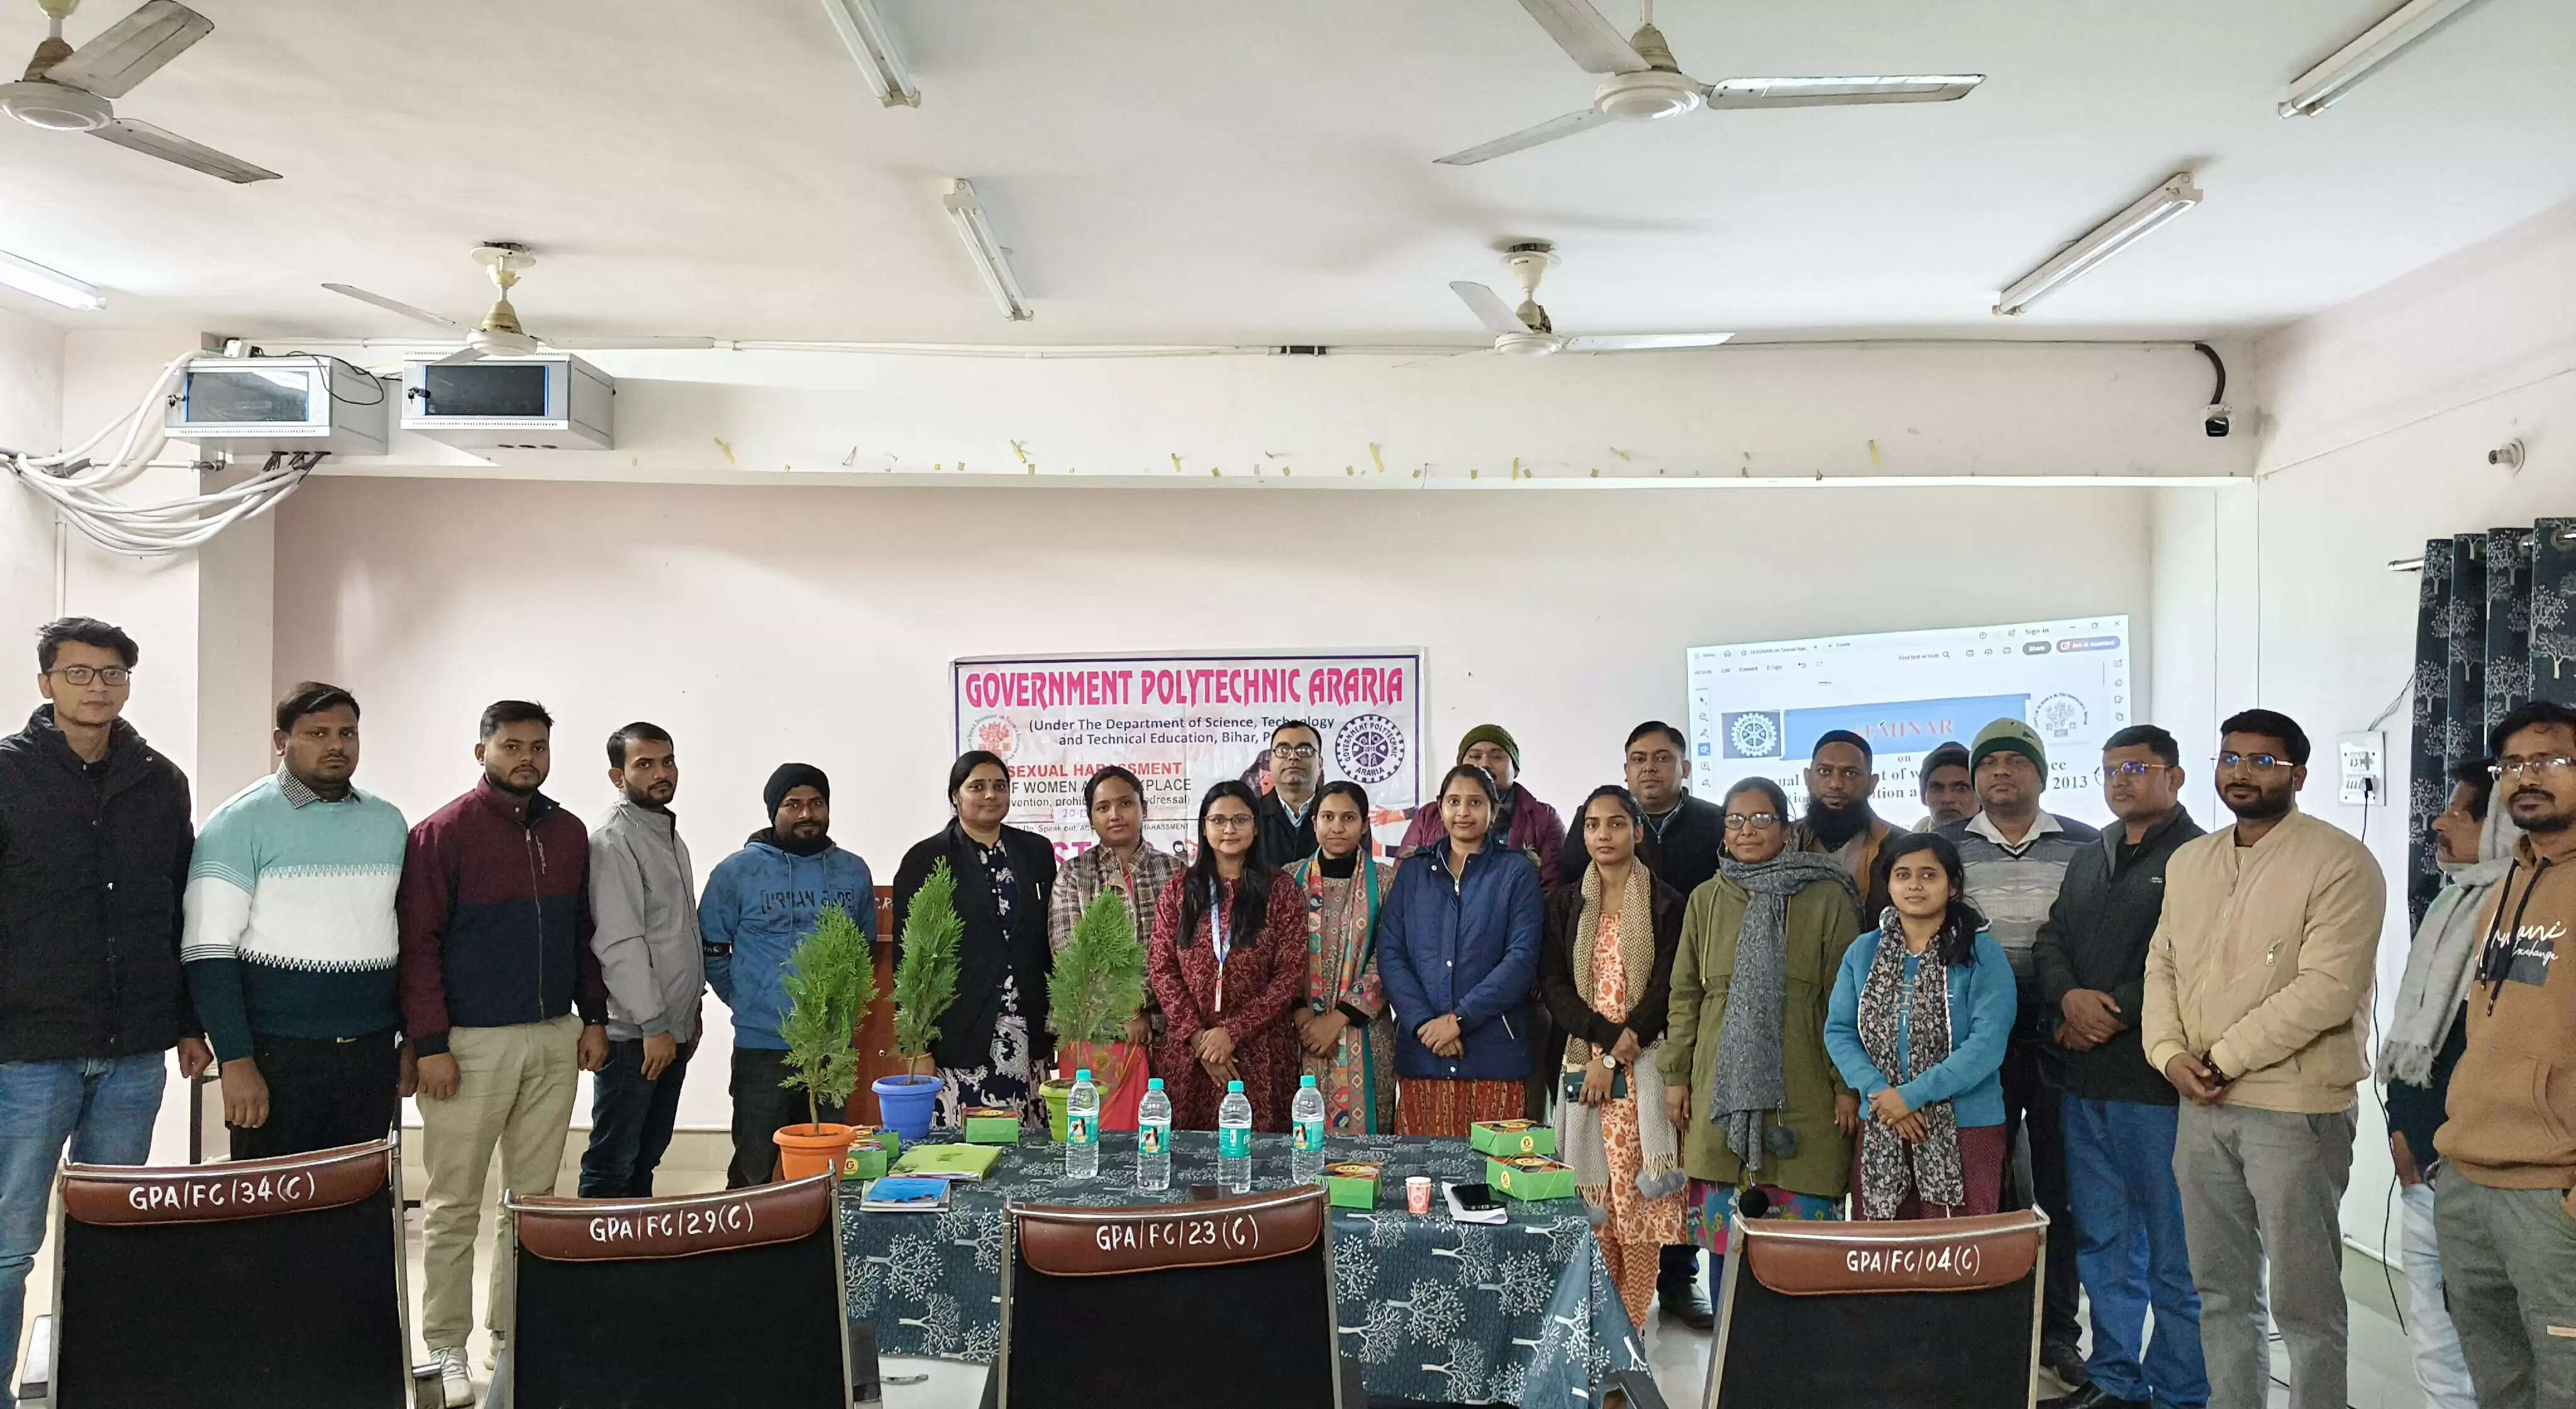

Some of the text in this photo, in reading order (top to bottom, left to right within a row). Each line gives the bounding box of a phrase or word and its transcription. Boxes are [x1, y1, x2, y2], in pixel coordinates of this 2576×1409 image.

[965, 667, 1403, 711] GOVERNMENT POLYTECHNIC ARARIA
[1030, 715, 1335, 733] (Under The Department of Science, Techology
[1059, 734, 1082, 745] and
[1086, 733, 1146, 745] Technical
[1150, 732, 1218, 745] Education,
[1222, 732, 1258, 744] Bihar,
[1008, 762, 1182, 778] SEXUAL HARSMENT
[1355, 767, 1385, 776] ARARIA
[1023, 781, 1077, 793] WOMEN
[2053, 776, 2088, 789] 2013
